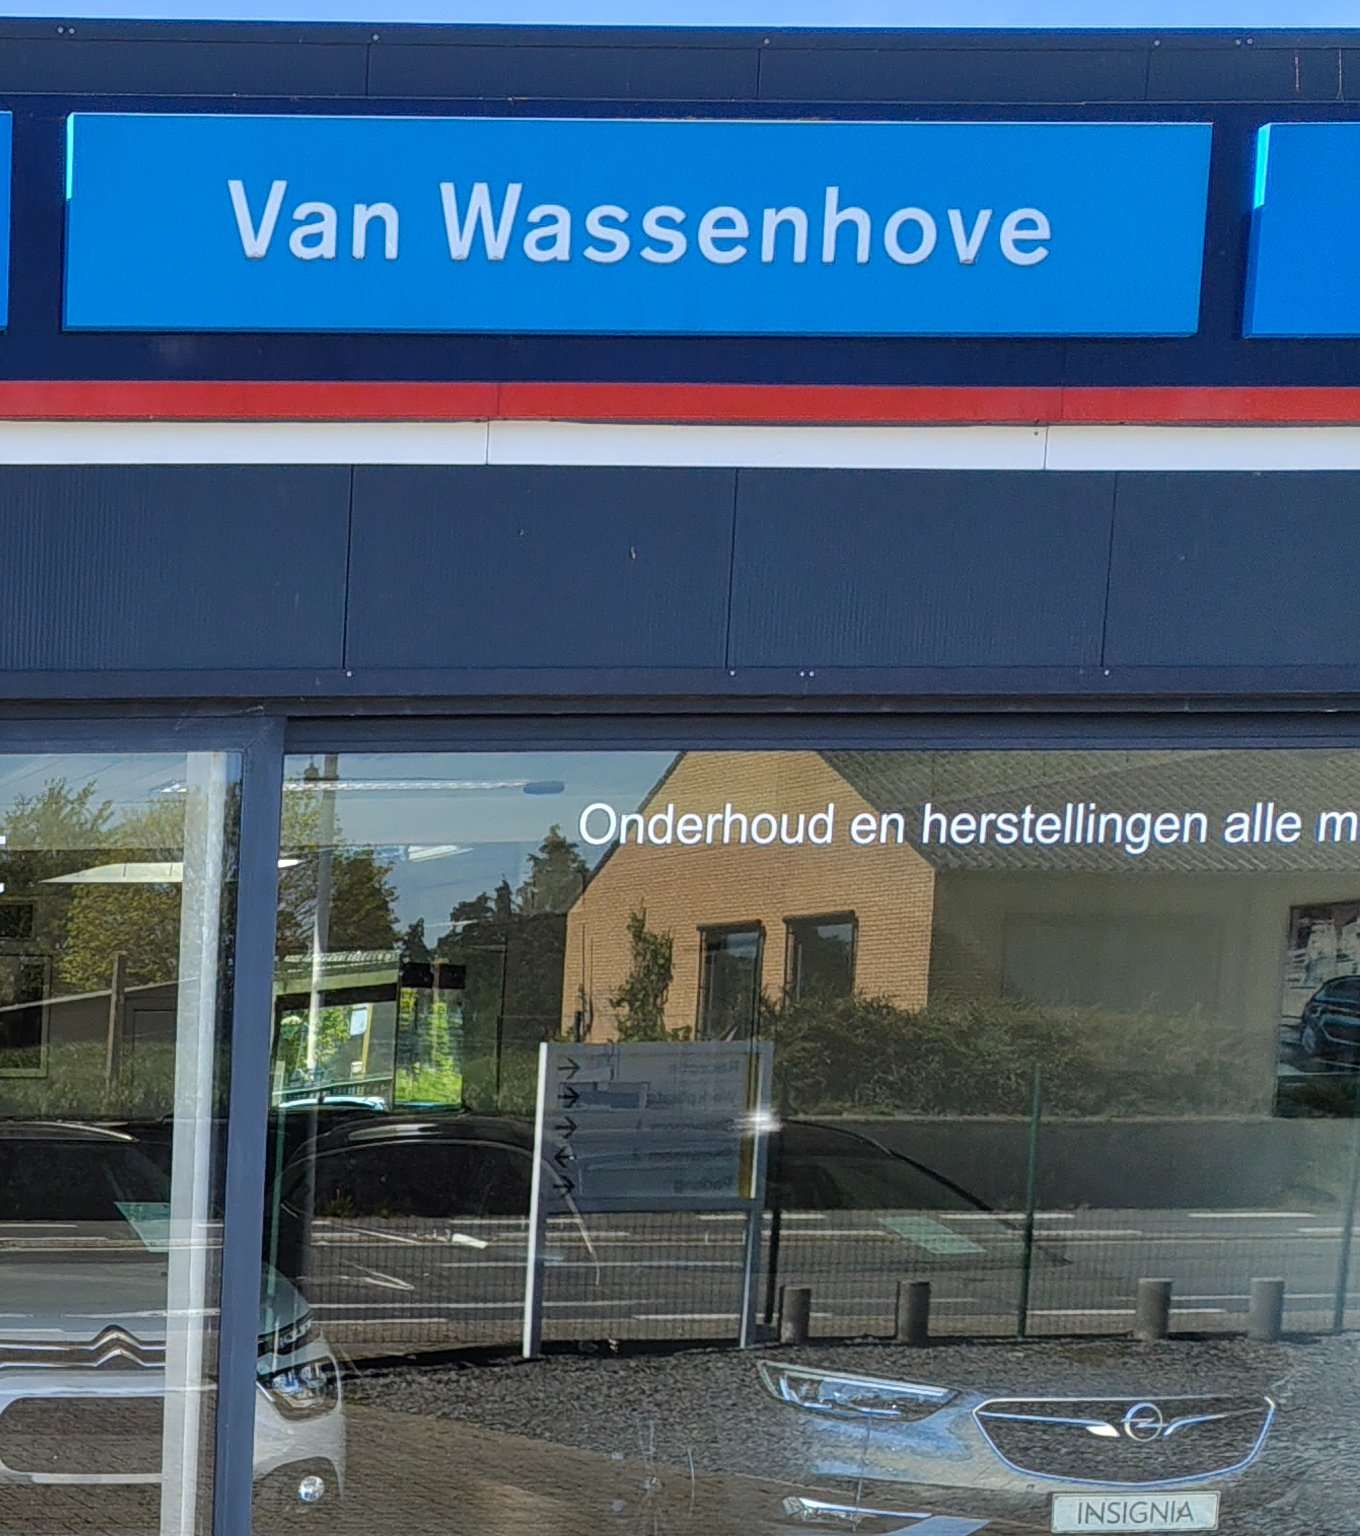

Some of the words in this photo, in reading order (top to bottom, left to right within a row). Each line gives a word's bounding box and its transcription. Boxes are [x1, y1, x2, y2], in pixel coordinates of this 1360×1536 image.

[228, 180, 399, 261] Van
[440, 182, 1051, 266] Wassenhove
[579, 803, 834, 845] Onderhoud
[850, 812, 905, 844] en
[922, 803, 1208, 855] herstellingen
[1224, 802, 1302, 843] alle
[1077, 1500, 1194, 1525] INSIGNIA
